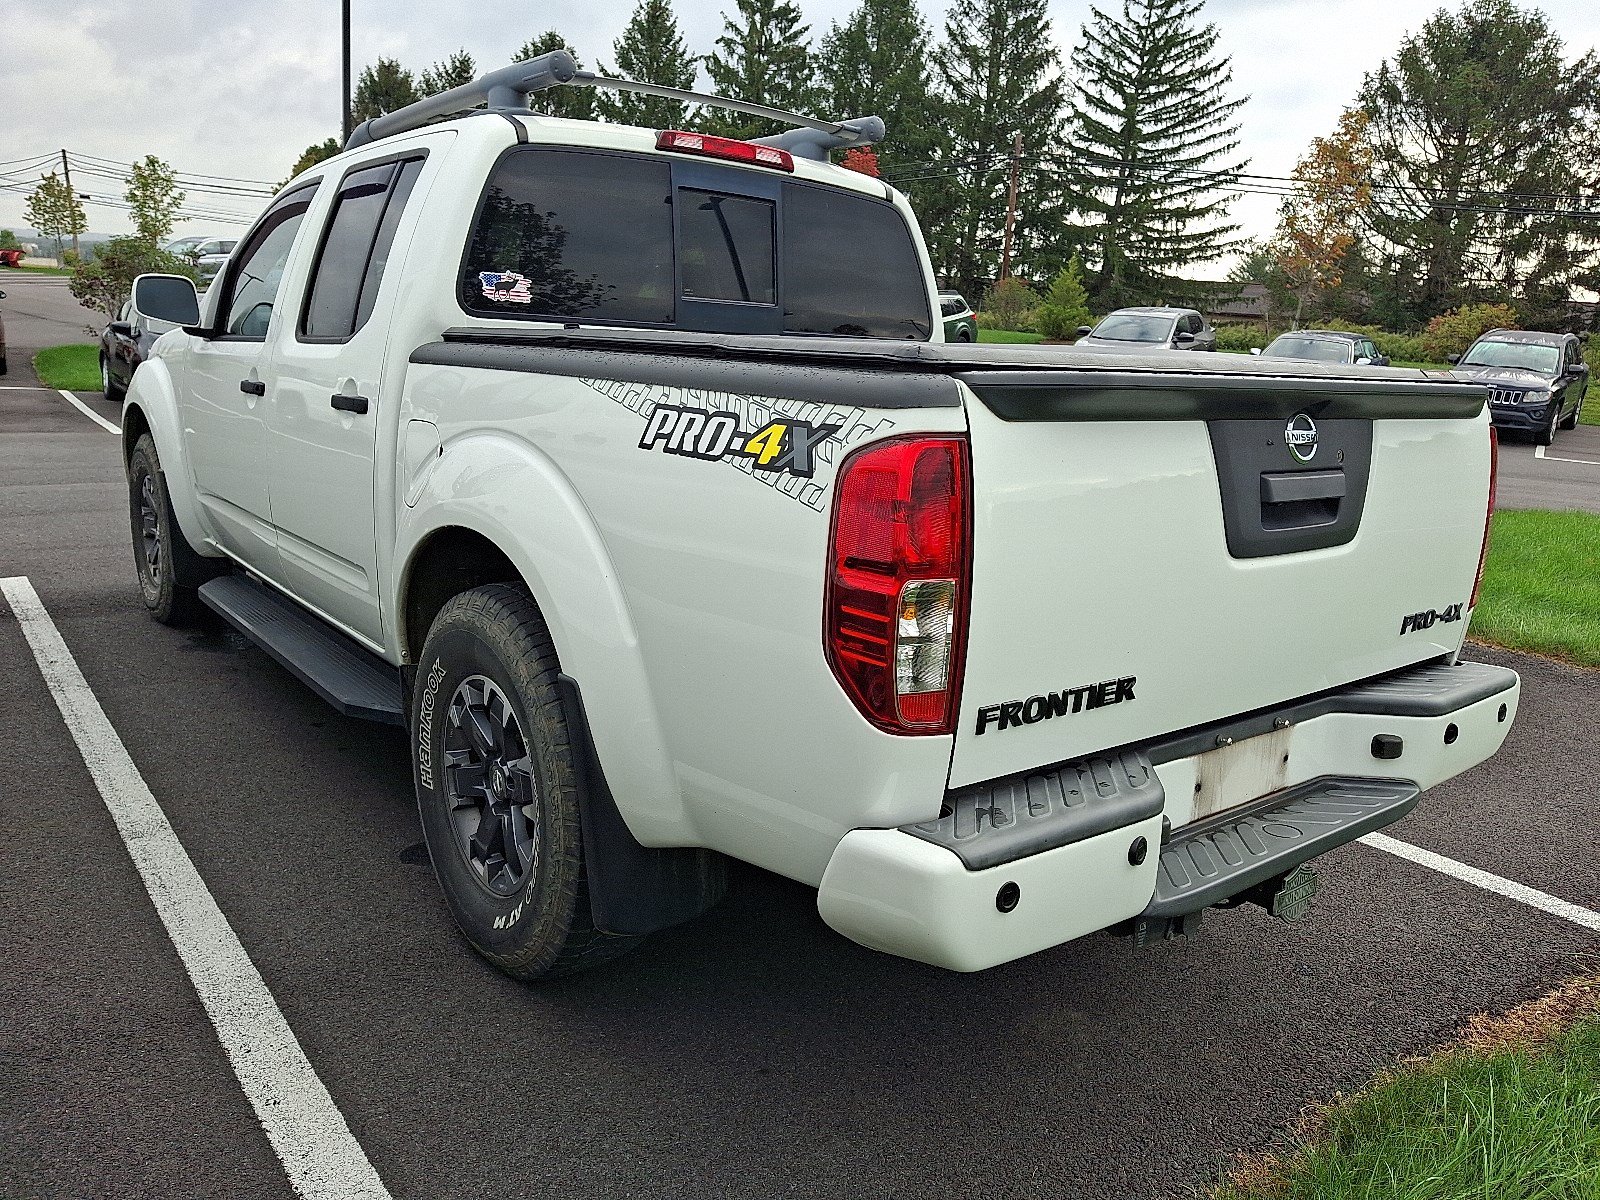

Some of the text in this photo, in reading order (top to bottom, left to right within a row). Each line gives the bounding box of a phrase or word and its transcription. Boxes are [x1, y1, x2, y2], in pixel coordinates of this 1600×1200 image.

[639, 405, 841, 478] PRO-4X
[1400, 602, 1463, 635] PRO-4X
[975, 675, 1137, 735] FRONTIER
